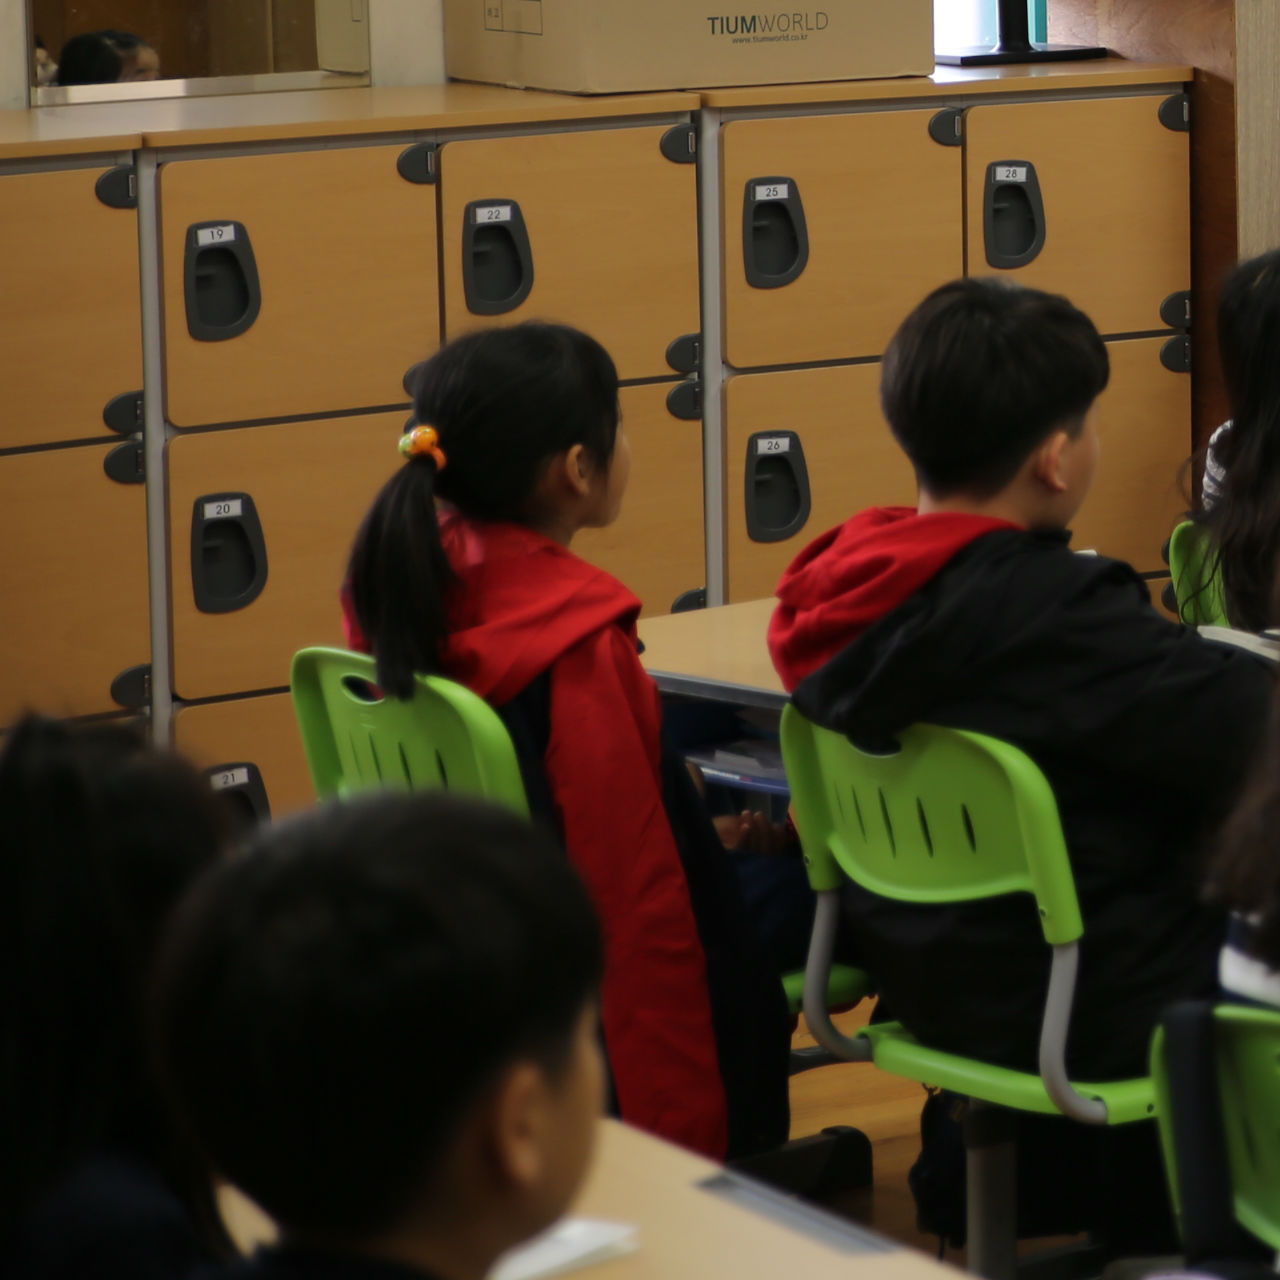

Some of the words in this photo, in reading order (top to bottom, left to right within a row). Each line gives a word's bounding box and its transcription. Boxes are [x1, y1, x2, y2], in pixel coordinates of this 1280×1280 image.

[707, 11, 829, 36] TIUMWORLD
[1005, 168, 1017, 179] 28
[765, 186, 778, 198] 25
[487, 209, 500, 220] 22
[210, 228, 224, 241] 19
[767, 440, 780, 451] 26
[216, 503, 230, 515] 20
[222, 772, 236, 786] 21
